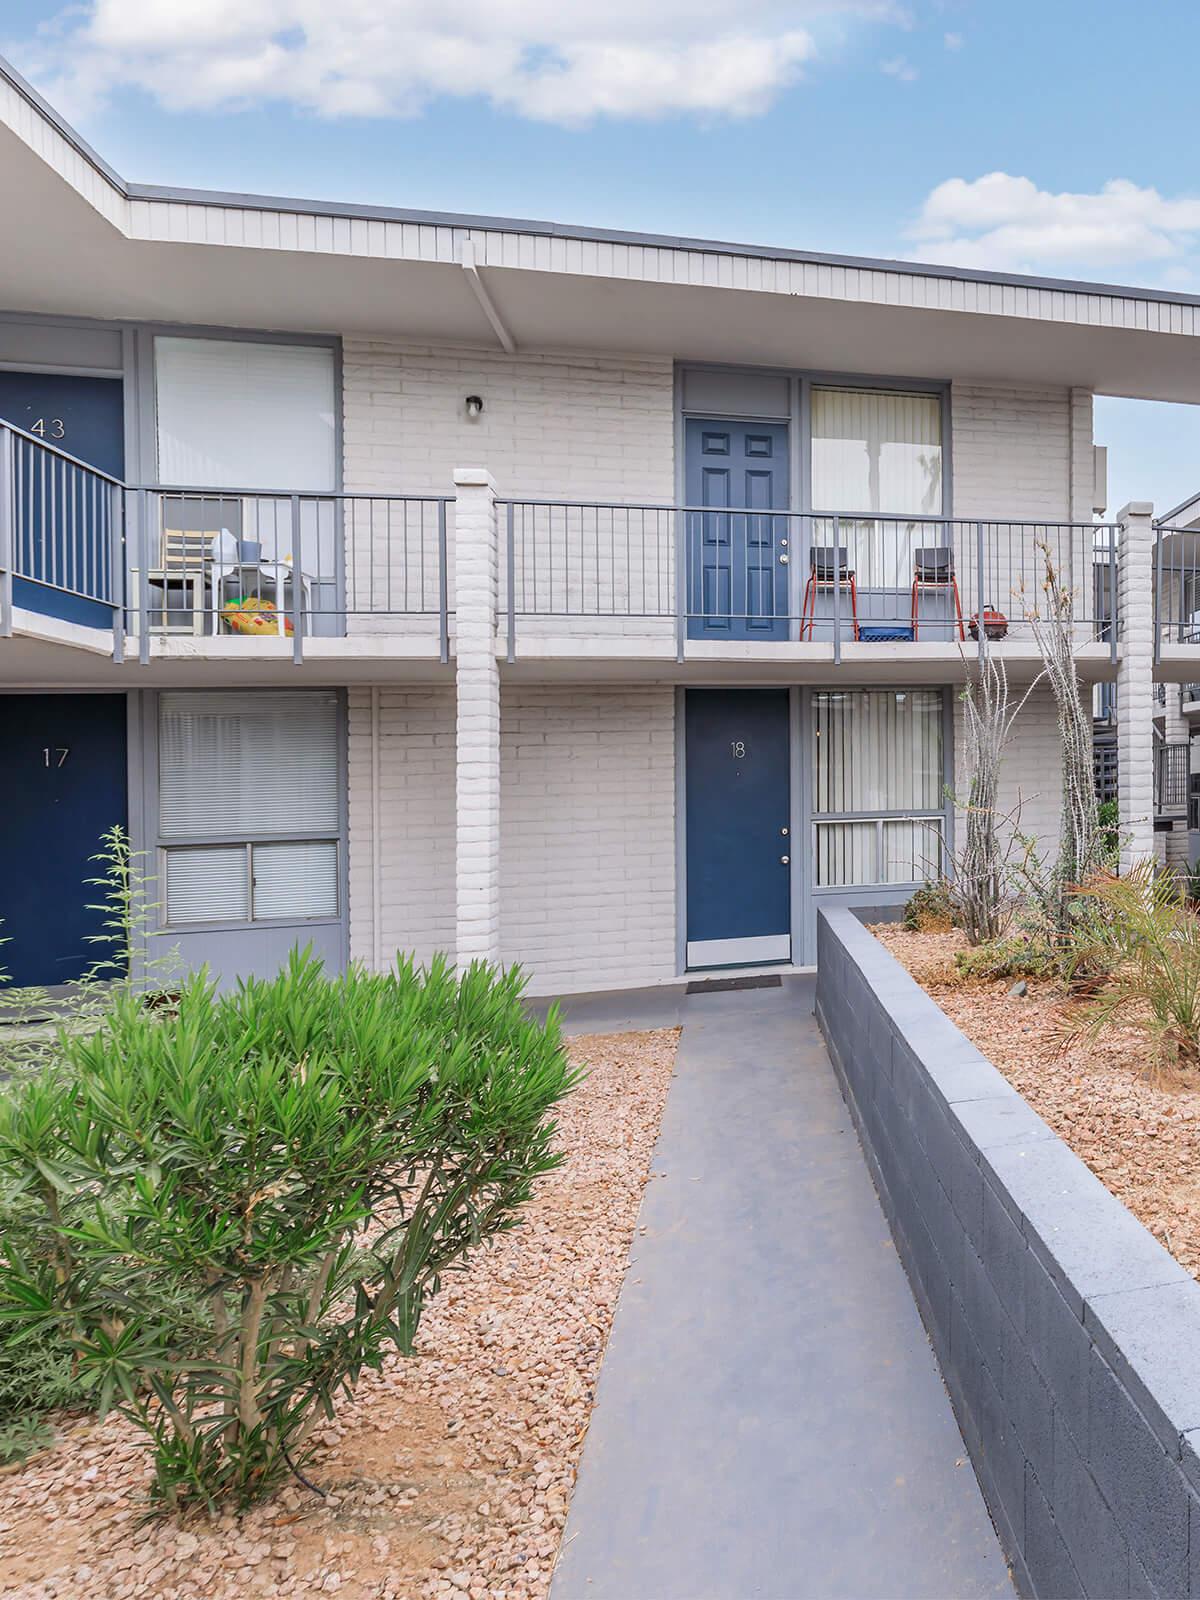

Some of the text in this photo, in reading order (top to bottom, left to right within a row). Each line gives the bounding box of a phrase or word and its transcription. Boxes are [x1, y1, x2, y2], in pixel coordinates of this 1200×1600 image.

[31, 418, 65, 438] 43
[42, 748, 69, 768] 17
[730, 741, 745, 759] 18
